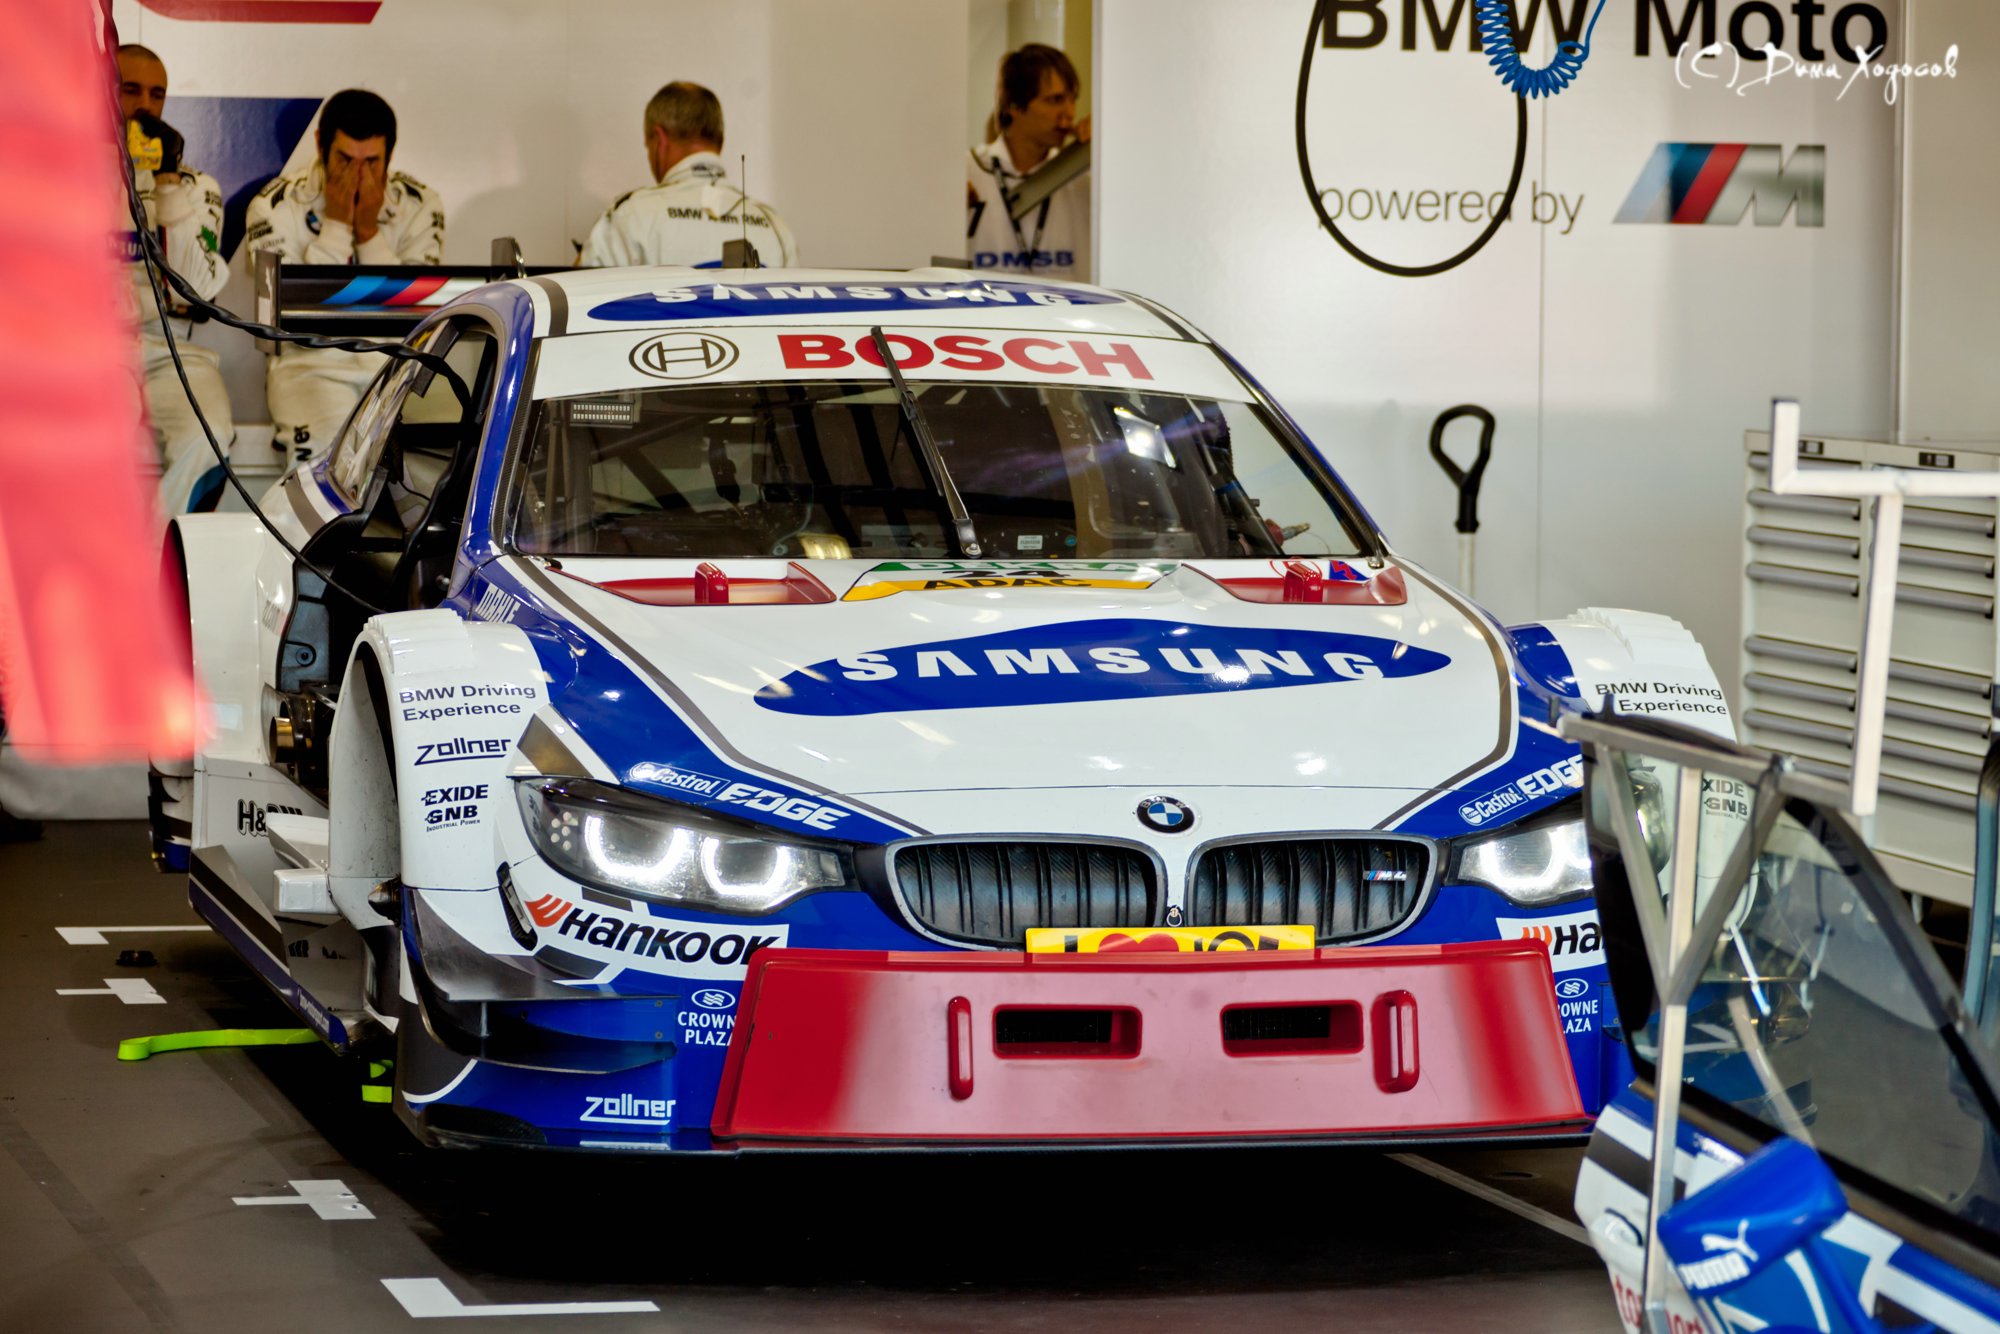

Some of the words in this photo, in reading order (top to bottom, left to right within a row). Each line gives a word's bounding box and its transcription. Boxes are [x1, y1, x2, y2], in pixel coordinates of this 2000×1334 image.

[1634, 0, 1888, 63] Moto
[667, 207, 703, 221] BMW
[1531, 180, 1584, 236] by
[975, 250, 1074, 269] DMSB
[652, 285, 1073, 307] SAMSUNG
[777, 334, 1154, 381] BOSCH
[923, 578, 1092, 590] ADAC
[837, 646, 1384, 682] SAMSUNG
[400, 686, 455, 704] BMW
[461, 684, 536, 699] Driving
[1595, 682, 1647, 695] BMW
[1653, 682, 1723, 700] Driving
[403, 703, 521, 722] Experience
[1618, 699, 1727, 715] Experience
[421, 784, 489, 807] EXIDE
[1702, 778, 1744, 798] XIDE
[652, 767, 721, 794] Castrol
[715, 782, 851, 831] EDGE
[1474, 787, 1524, 818] Castrol
[1704, 797, 1748, 816] GNB
[425, 805, 479, 824] GNB
[1552, 921, 1603, 956] Ha
[1558, 999, 1599, 1018] OWNE
[677, 1011, 737, 1029] CROWN
[1563, 1017, 1592, 1034] AZA
